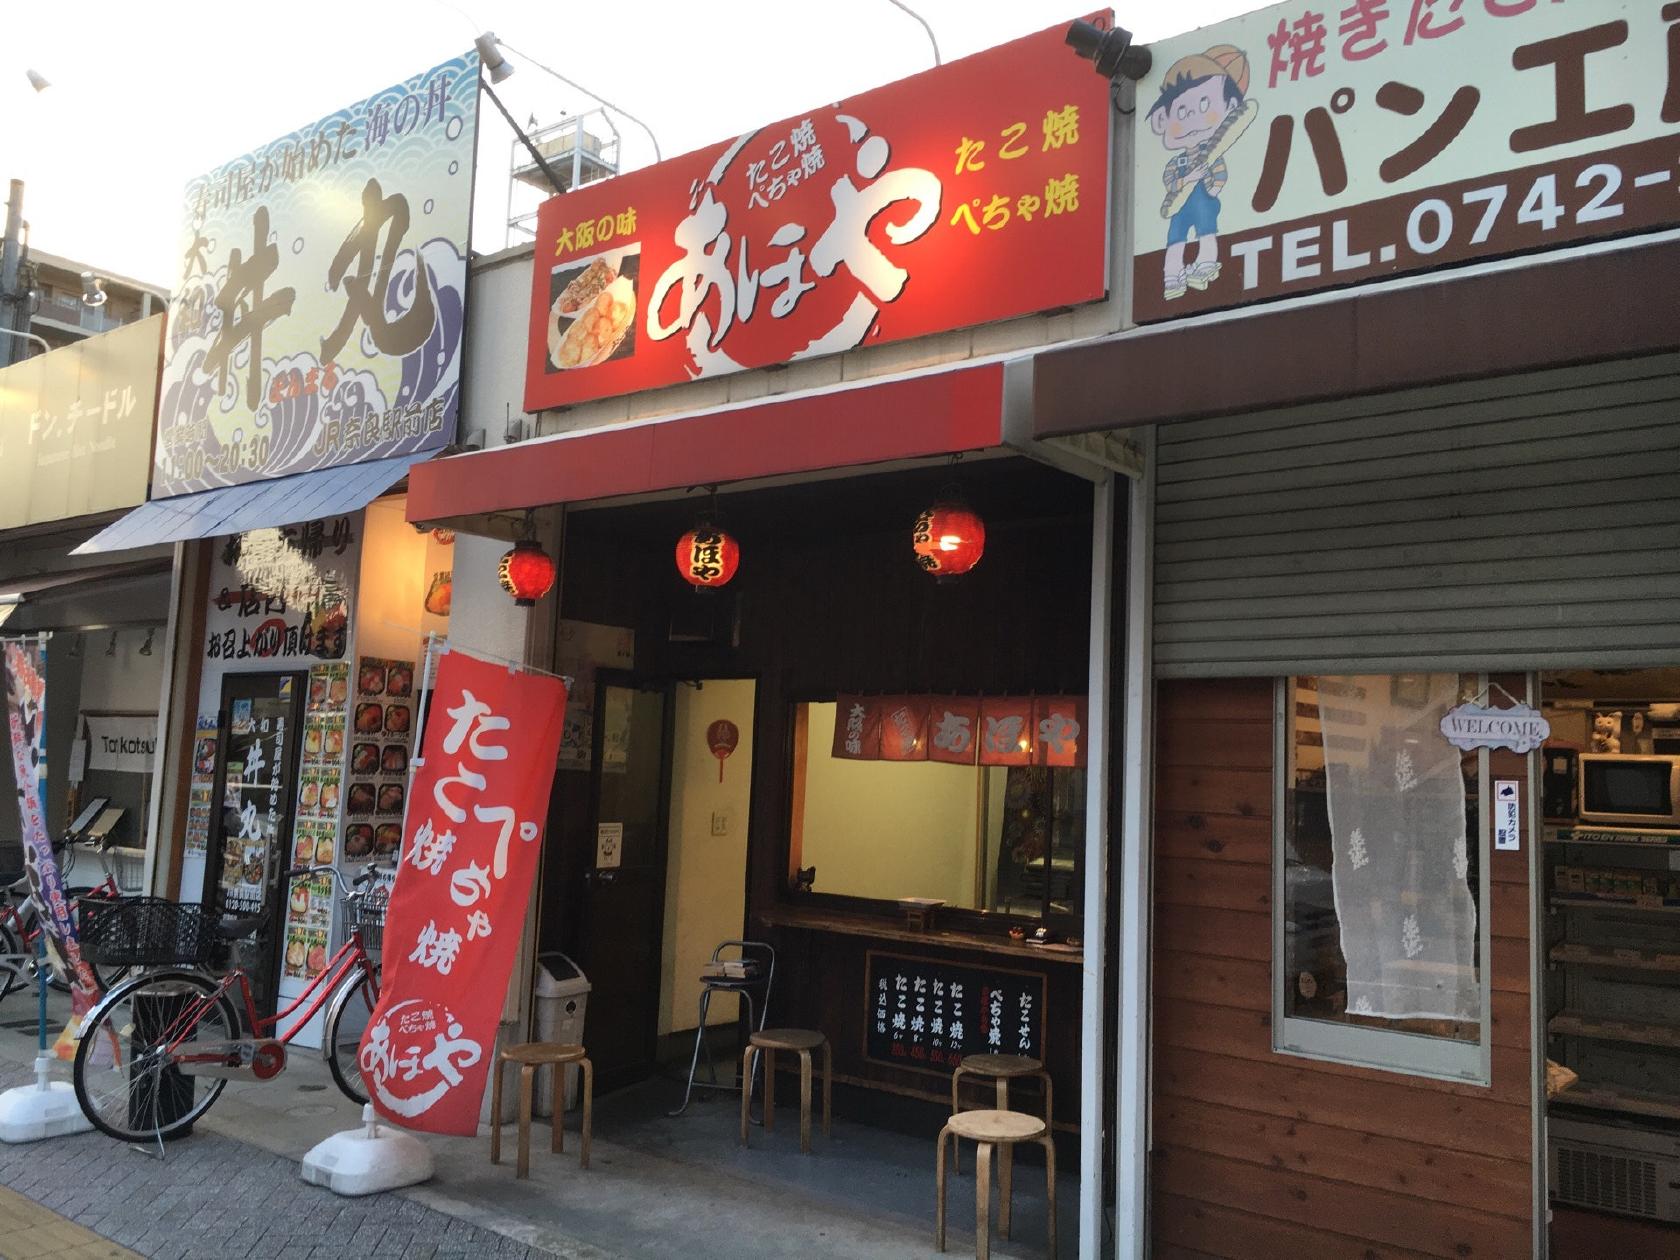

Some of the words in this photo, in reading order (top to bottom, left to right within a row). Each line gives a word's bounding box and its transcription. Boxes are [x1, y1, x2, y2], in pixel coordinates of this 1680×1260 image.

[1267, 0, 1566, 88] 焼きた
[1251, 2, 1680, 213] パン工
[746, 117, 817, 191] たこ焼
[955, 104, 1080, 176] たこ焼
[555, 206, 637, 256] 大阪の味
[646, 138, 943, 348] あほや
[1231, 156, 1680, 291] TEL.0742-
[312, 397, 446, 456] JR奈良駅前店
[1451, 718, 1541, 738] WELCOME
[892, 973, 908, 1030] たこ焼
[911, 975, 927, 1033] たこ焼
[931, 978, 944, 1035] たこ焼
[949, 981, 964, 1040] たこ焼
